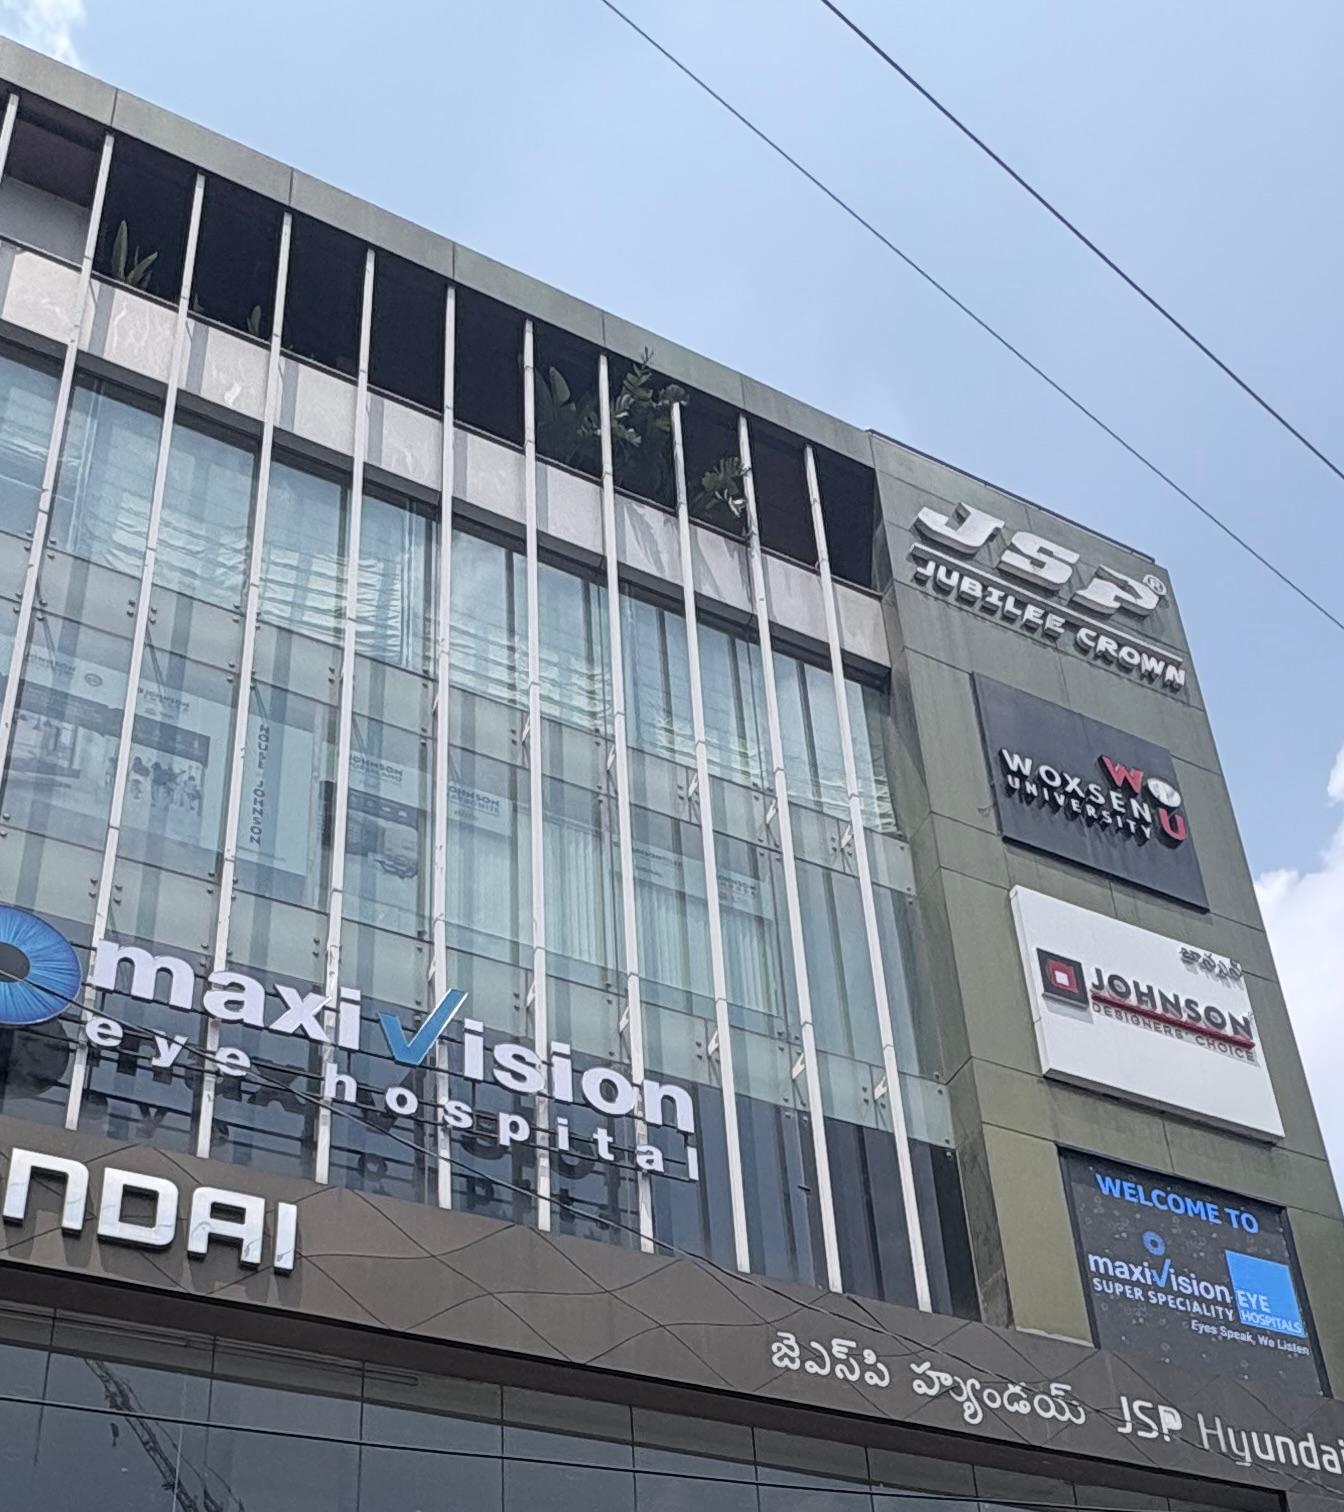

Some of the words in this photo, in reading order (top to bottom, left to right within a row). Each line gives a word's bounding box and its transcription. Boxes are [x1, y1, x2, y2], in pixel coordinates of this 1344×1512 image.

[916, 560, 1066, 637] JUBILEE
[1076, 627, 1186, 688] CROWN
[1001, 748, 1153, 823] WOXSEN
[1007, 774, 1152, 840] UNIVERSITY
[1091, 966, 1254, 1041] JOHNSON
[1195, 1034, 1256, 1062] CHOICE
[86, 1012, 253, 1079] eye
[323, 1061, 700, 1183] hospital
[1094, 1171, 1223, 1225] WELCOME
[1224, 1206, 1260, 1235] TO
[1092, 1276, 1145, 1302] SUPER
[1147, 1289, 1235, 1322] SPECIALITY
[1235, 1288, 1272, 1313] EYE
[1241, 1310, 1304, 1335] HOSPITALS
[1190, 1319, 1219, 1335] Eyes
[1257, 1334, 1275, 1349] We
[1276, 1336, 1311, 1356] Listen
[1117, 1395, 1183, 1443] JSP
